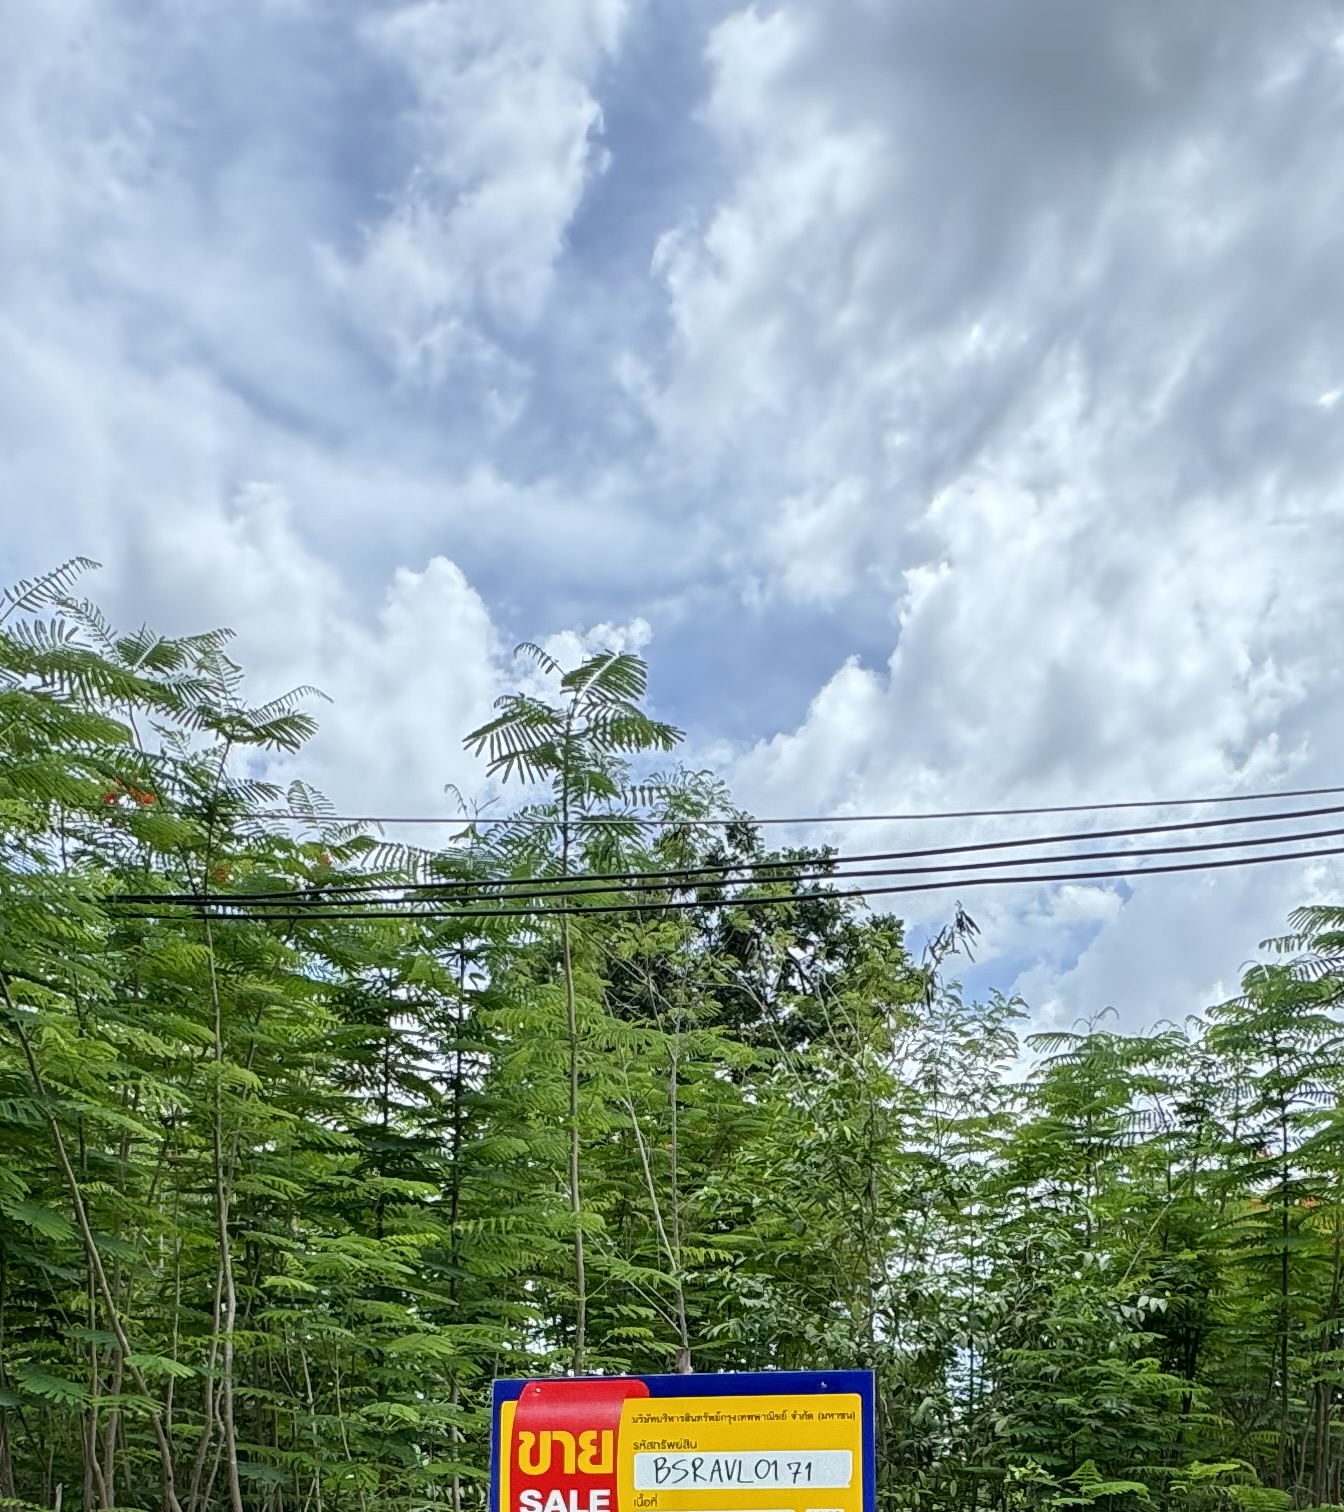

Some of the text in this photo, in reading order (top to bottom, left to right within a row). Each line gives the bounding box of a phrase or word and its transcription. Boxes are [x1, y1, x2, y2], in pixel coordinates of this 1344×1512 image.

[518, 1430, 614, 1475] ขาย
[633, 1492, 658, 1508] เนื้อที่
